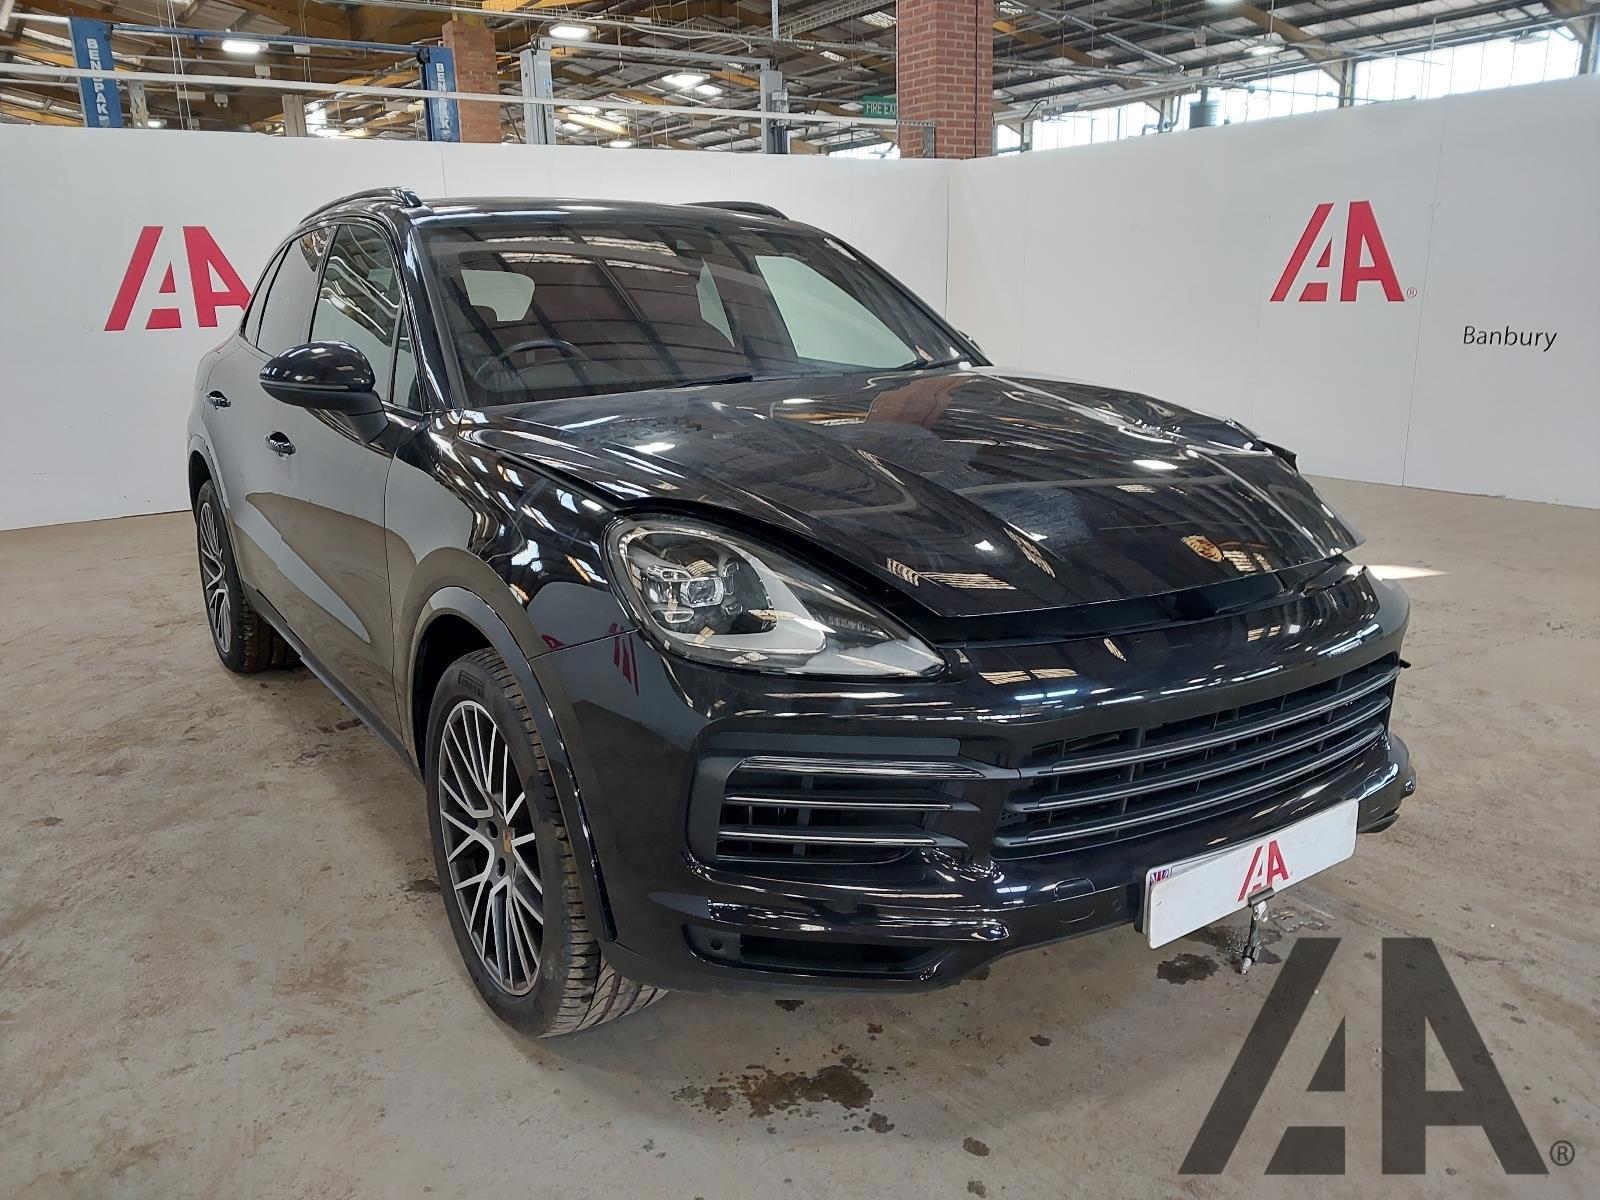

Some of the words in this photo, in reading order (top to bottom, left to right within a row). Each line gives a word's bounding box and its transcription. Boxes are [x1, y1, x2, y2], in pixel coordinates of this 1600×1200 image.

[866, 103, 882, 115] FIRE
[884, 103, 896, 115] EXI
[1463, 325, 1557, 352] Banbury
